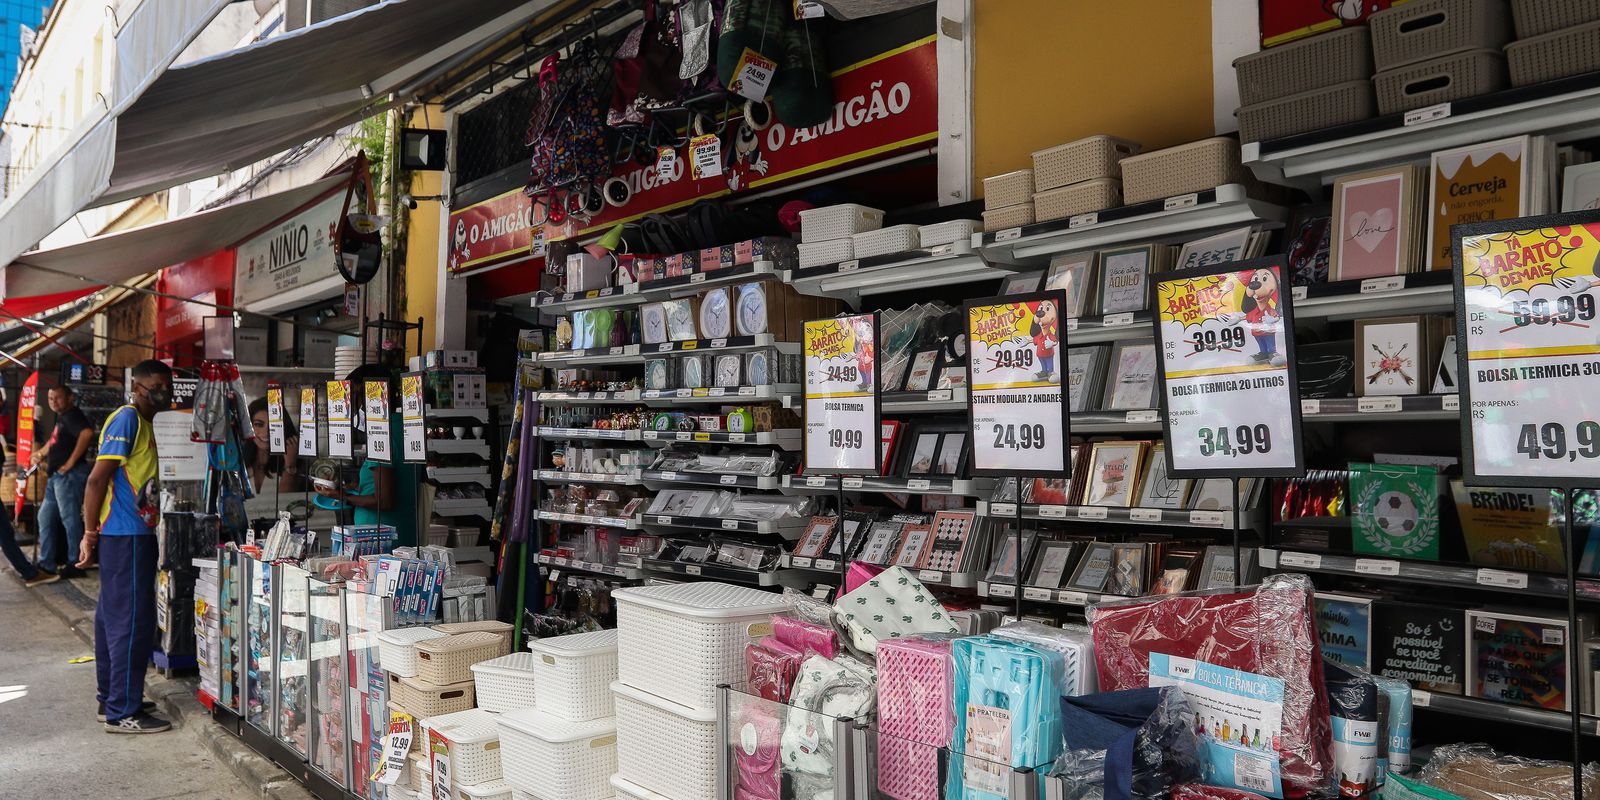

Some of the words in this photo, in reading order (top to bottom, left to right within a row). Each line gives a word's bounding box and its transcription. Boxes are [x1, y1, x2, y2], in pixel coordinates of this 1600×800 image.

[767, 123, 785, 152] O
[1450, 176, 1506, 198] Cerveja
[470, 224, 479, 244] O
[481, 202, 536, 241] AMIGÃO
[1346, 218, 1397, 241] love
[269, 224, 308, 270] NINIO
[1478, 238, 1562, 278] BARATO
[1500, 263, 1554, 288] DEMAIS
[1168, 284, 1222, 314] BARATO
[1184, 302, 1218, 322] DEMAIS
[1470, 312, 1487, 322] DE:
[1513, 293, 1596, 327] 59,99
[977, 310, 1016, 335] BARATO
[1471, 326, 1483, 336] R$
[812, 330, 842, 351] BARATO
[987, 327, 1012, 342] DEMAIS
[1193, 326, 1245, 352] 39,99
[995, 348, 1033, 369] 29,99
[828, 366, 857, 383] 24,99
[1478, 367, 1518, 382] BOLSA
[1520, 363, 1581, 380] TERMICA
[1172, 385, 1199, 396] BOLSA
[1200, 379, 1238, 395] TERMICA
[1239, 379, 1250, 390] 20
[1252, 376, 1284, 388] LITROS
[841, 403, 864, 412] TERMICA
[997, 394, 1027, 403] MODULAR
[1028, 394, 1032, 403] 2
[1033, 393, 1062, 403] ANDARES
[1472, 410, 1485, 419] R$
[828, 429, 863, 449] 19,99
[993, 424, 1045, 452] 24,99
[1199, 424, 1271, 457] 34,99
[1517, 420, 1600, 462] 49,9
[1476, 619, 1495, 632] COFRE
[1319, 630, 1356, 647] XIMA
[1393, 634, 1444, 650] possível
[1396, 648, 1410, 656] se
[1413, 648, 1441, 660] você
[1523, 650, 1547, 662] QUE
[1386, 657, 1442, 672] acreditar
[1198, 668, 1222, 686] BOLSA
[1381, 668, 1457, 686] economizar!
[1487, 674, 1500, 683] SE
[977, 708, 1010, 720] PRATELEIRA
